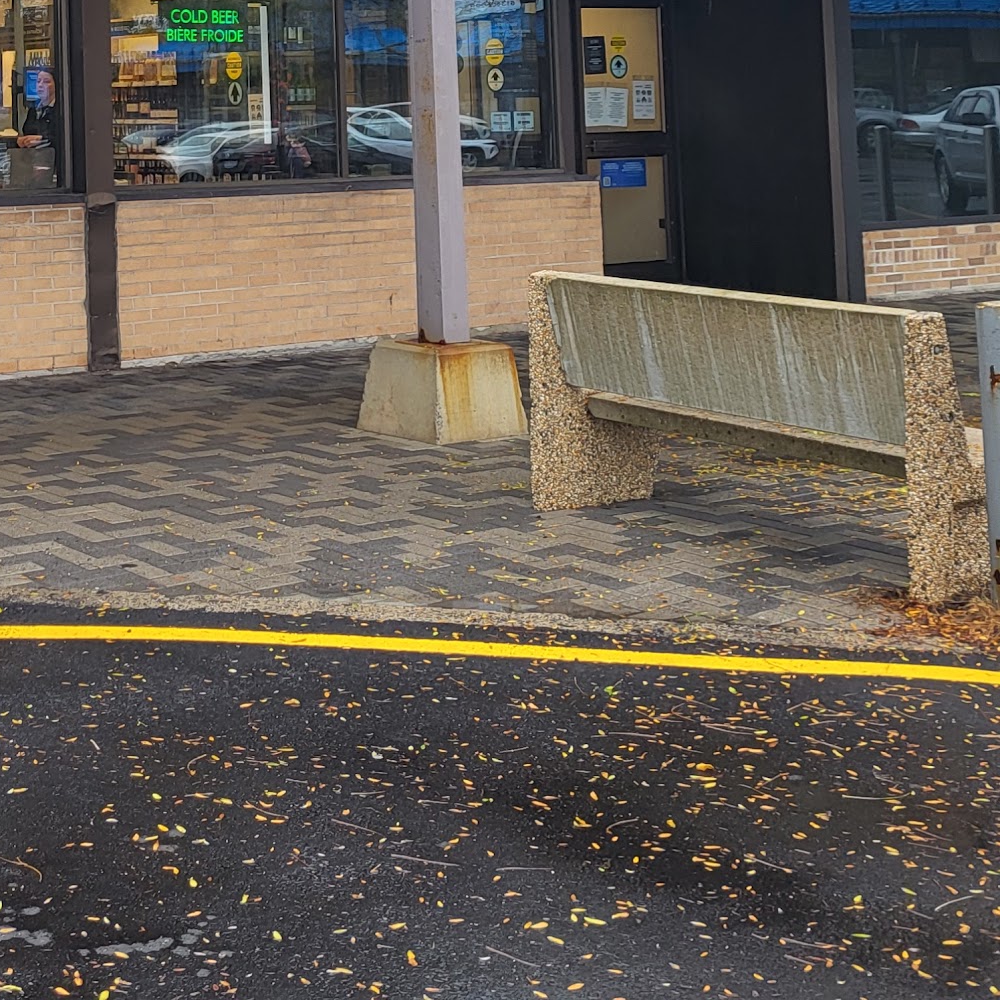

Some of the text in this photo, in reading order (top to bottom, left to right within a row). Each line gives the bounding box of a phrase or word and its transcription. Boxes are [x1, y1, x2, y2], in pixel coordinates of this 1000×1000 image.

[170, 8, 240, 25] COLD BEER
[166, 25, 244, 43] BIÈRE FROIDE
